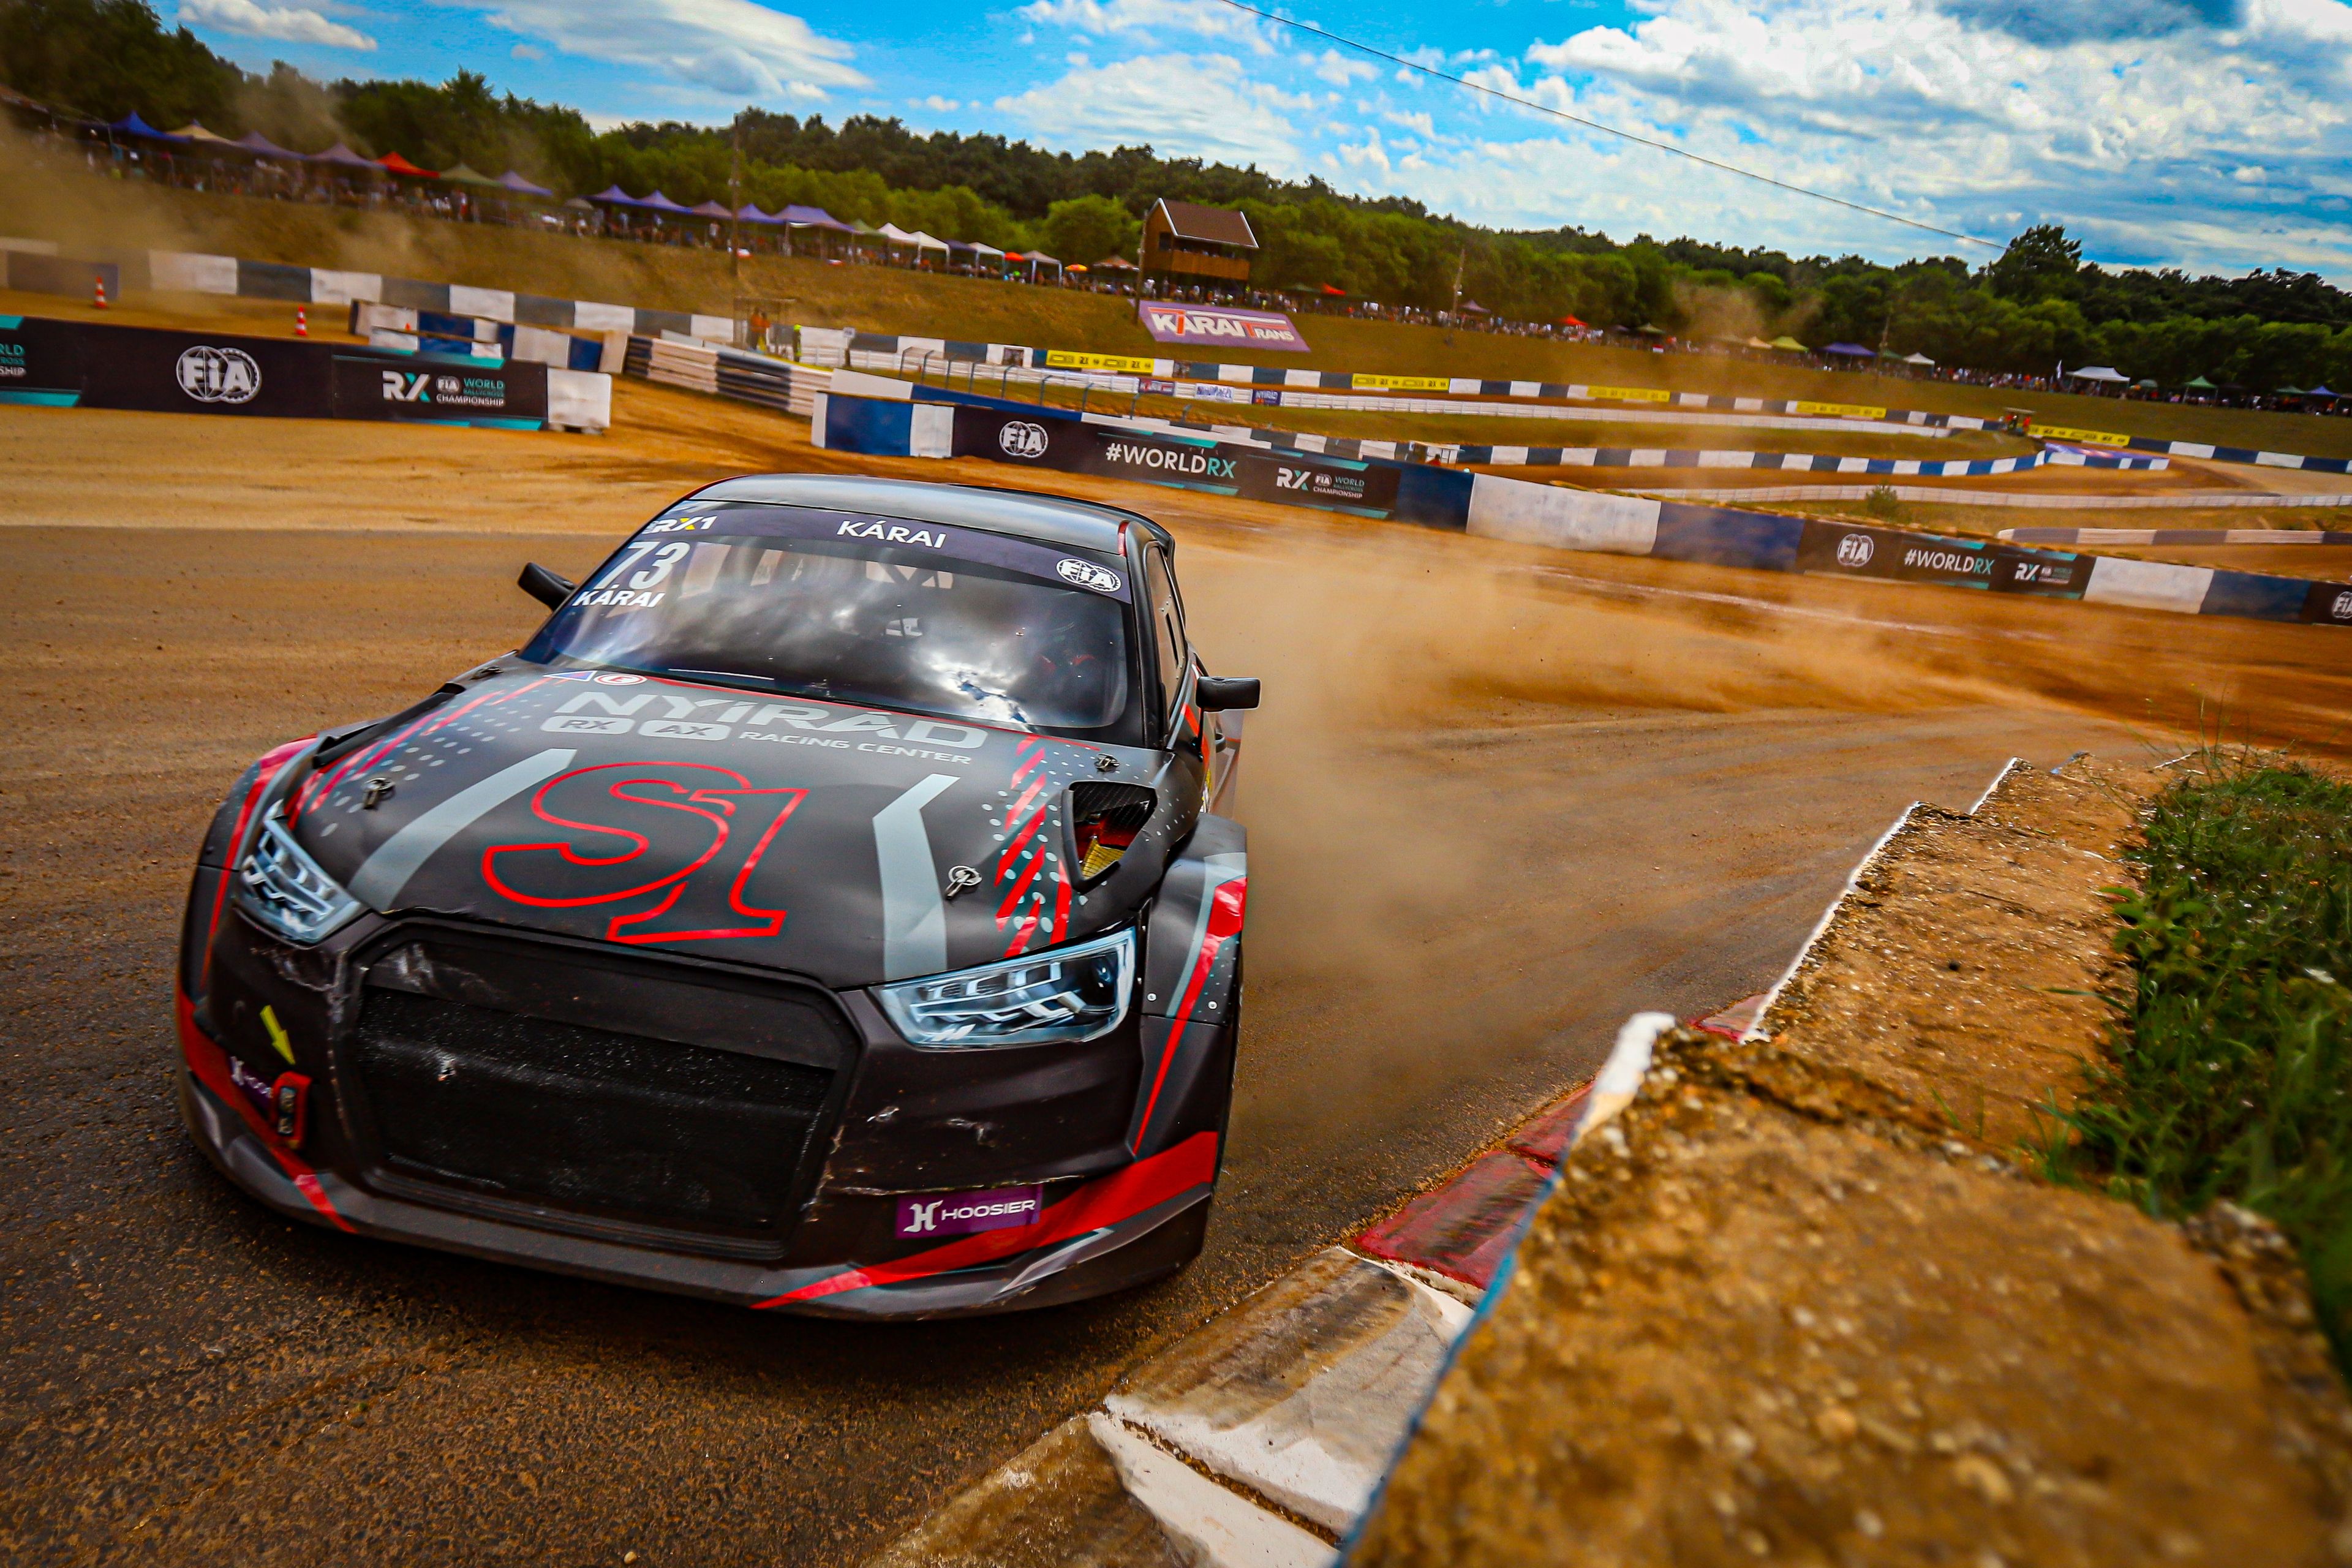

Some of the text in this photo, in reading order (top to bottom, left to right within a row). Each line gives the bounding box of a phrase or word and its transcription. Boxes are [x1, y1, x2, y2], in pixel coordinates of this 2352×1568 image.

[181, 353, 254, 395] FIA
[382, 371, 431, 402] RX
[464, 377, 505, 390] WORLD
[436, 394, 505, 406] CHAMPIONSHIP
[1002, 426, 1044, 454] FIA
[1106, 443, 1237, 478] #WORLDRX
[1276, 467, 1311, 491] RX
[1335, 476, 1365, 486] WORLD
[1313, 486, 1363, 499] CHAMPIONSHIP
[837, 520, 947, 548] KÁRAI
[1839, 538, 1870, 563] FIA
[1904, 549, 1995, 575] #WORLDRX
[594, 541, 690, 589] 73
[1060, 560, 1116, 590] FIA
[560, 720, 617, 730] RX
[654, 725, 714, 736] AX
[739, 731, 971, 765] RACING CENTER
[941, 1199, 1036, 1221] HOOSIER
